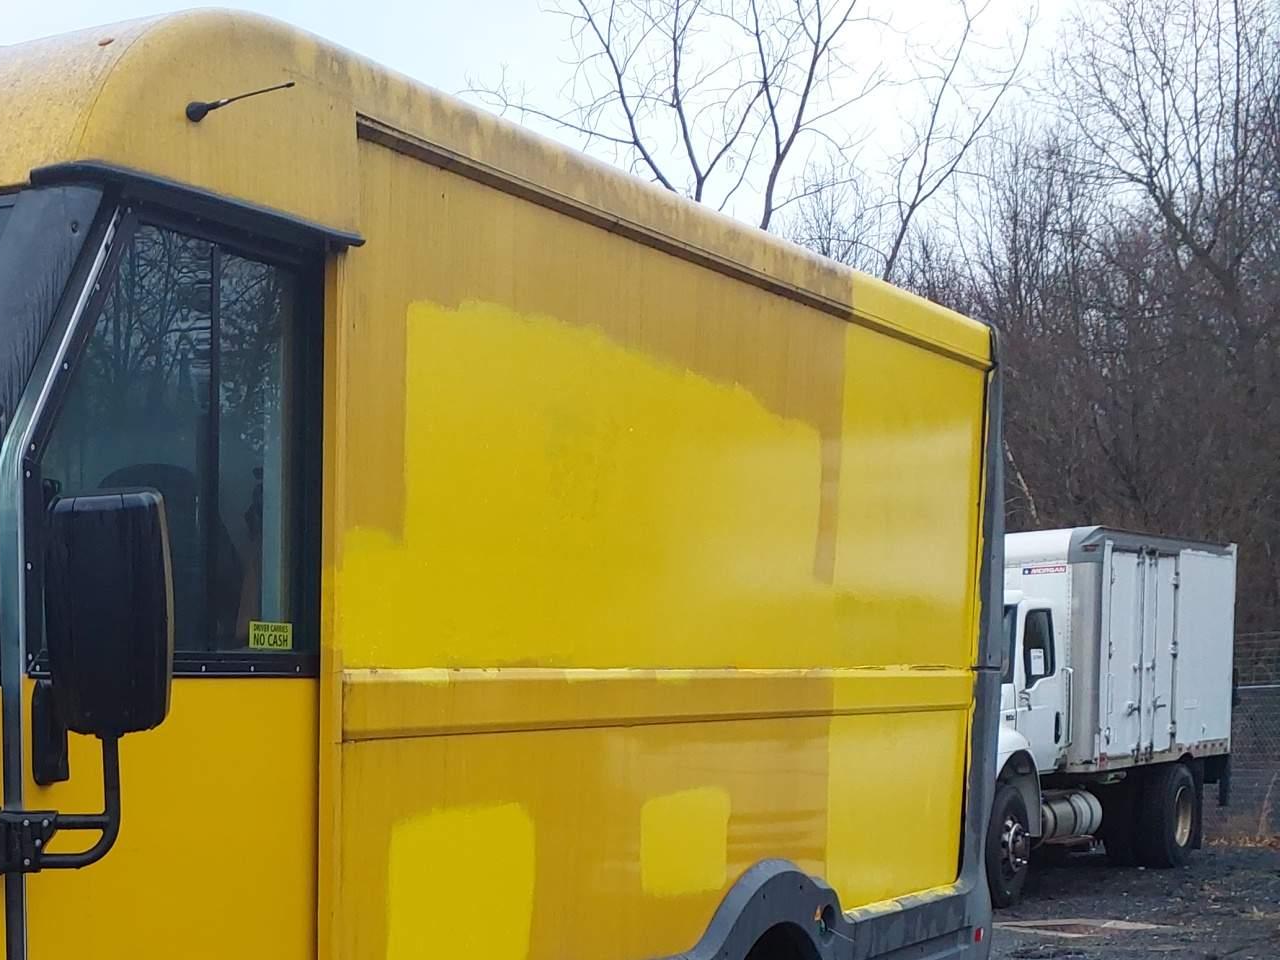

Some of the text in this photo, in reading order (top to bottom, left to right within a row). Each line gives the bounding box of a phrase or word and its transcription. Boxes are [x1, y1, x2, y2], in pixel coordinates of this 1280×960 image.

[1031, 566, 1064, 574] MORGAN
[254, 624, 288, 633] DRIVER CARRIES
[253, 633, 288, 647] NO CASH
